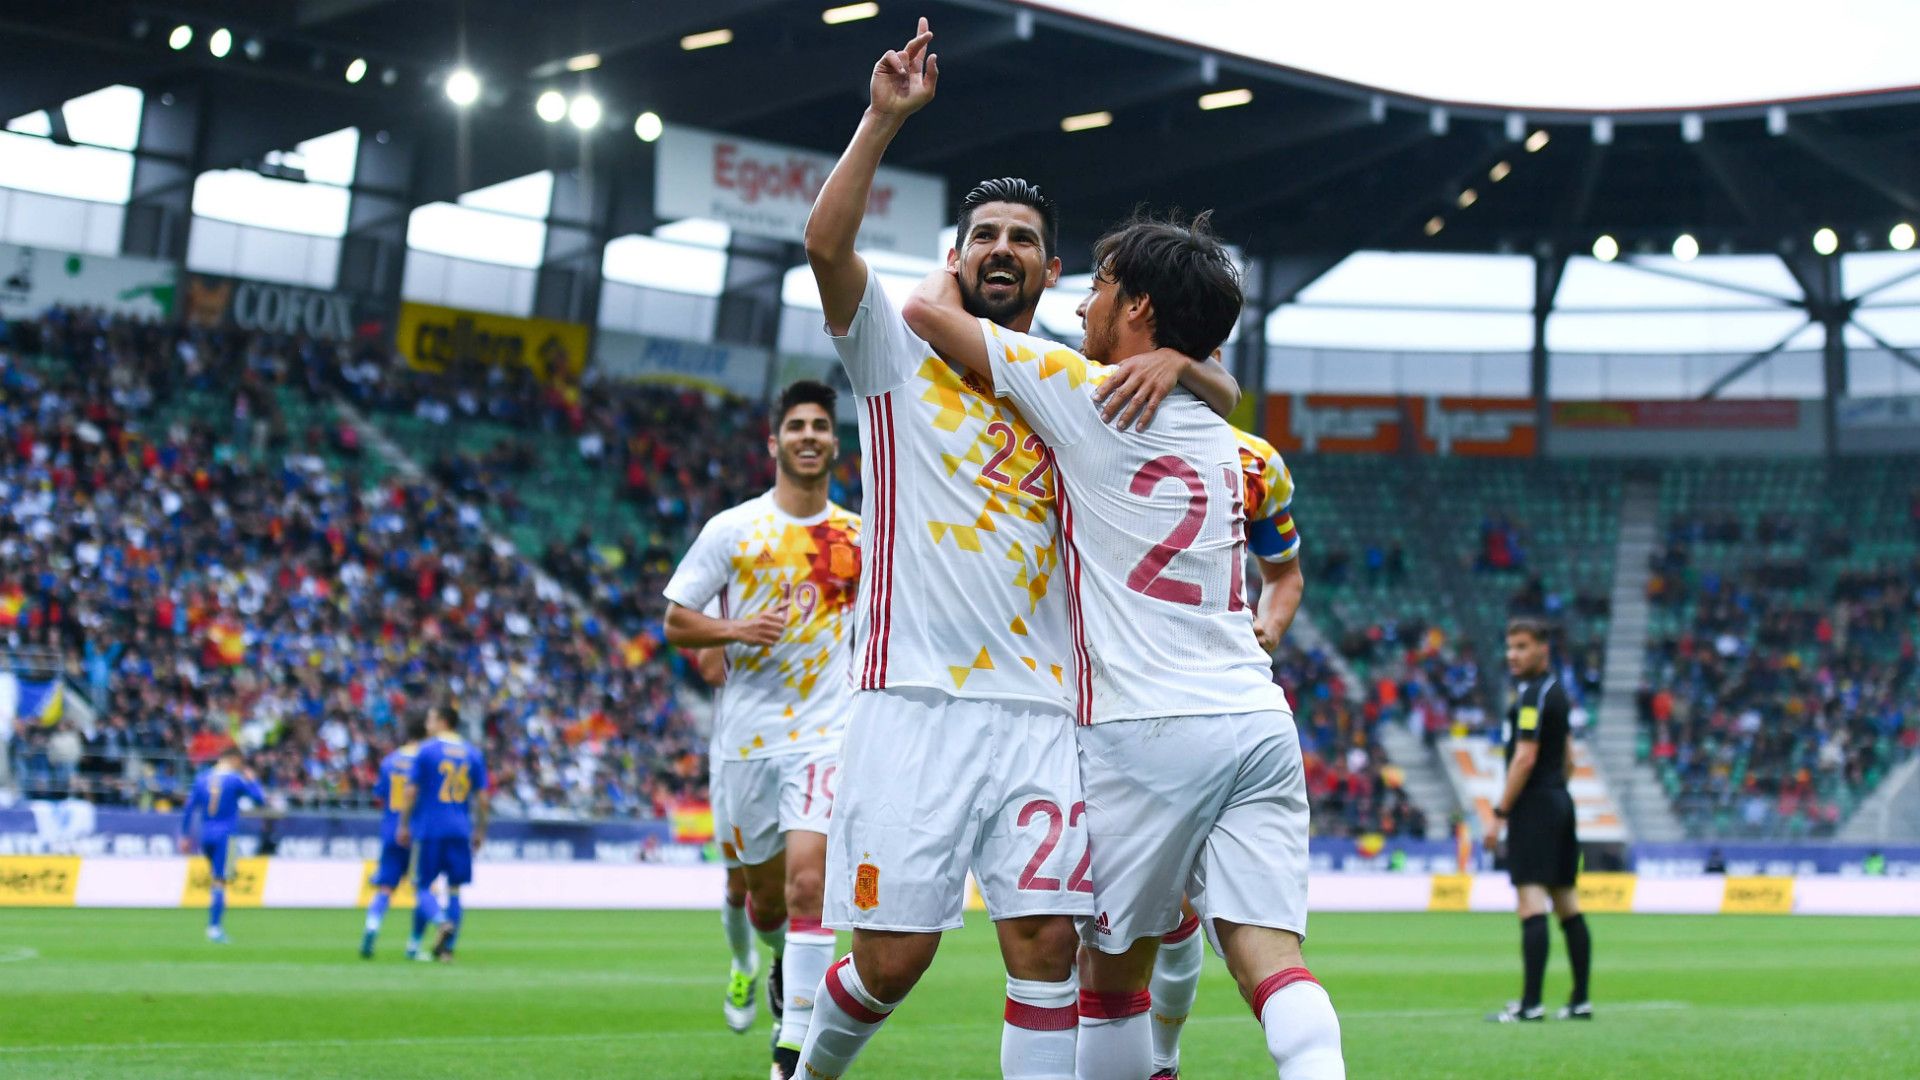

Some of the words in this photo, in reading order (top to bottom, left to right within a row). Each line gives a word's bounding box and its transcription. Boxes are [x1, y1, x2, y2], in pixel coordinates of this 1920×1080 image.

[981, 420, 1052, 500] 22
[1126, 455, 1245, 612] 21
[780, 581, 818, 625] 19
[438, 760, 471, 803] 26
[1016, 799, 1094, 893] 22
